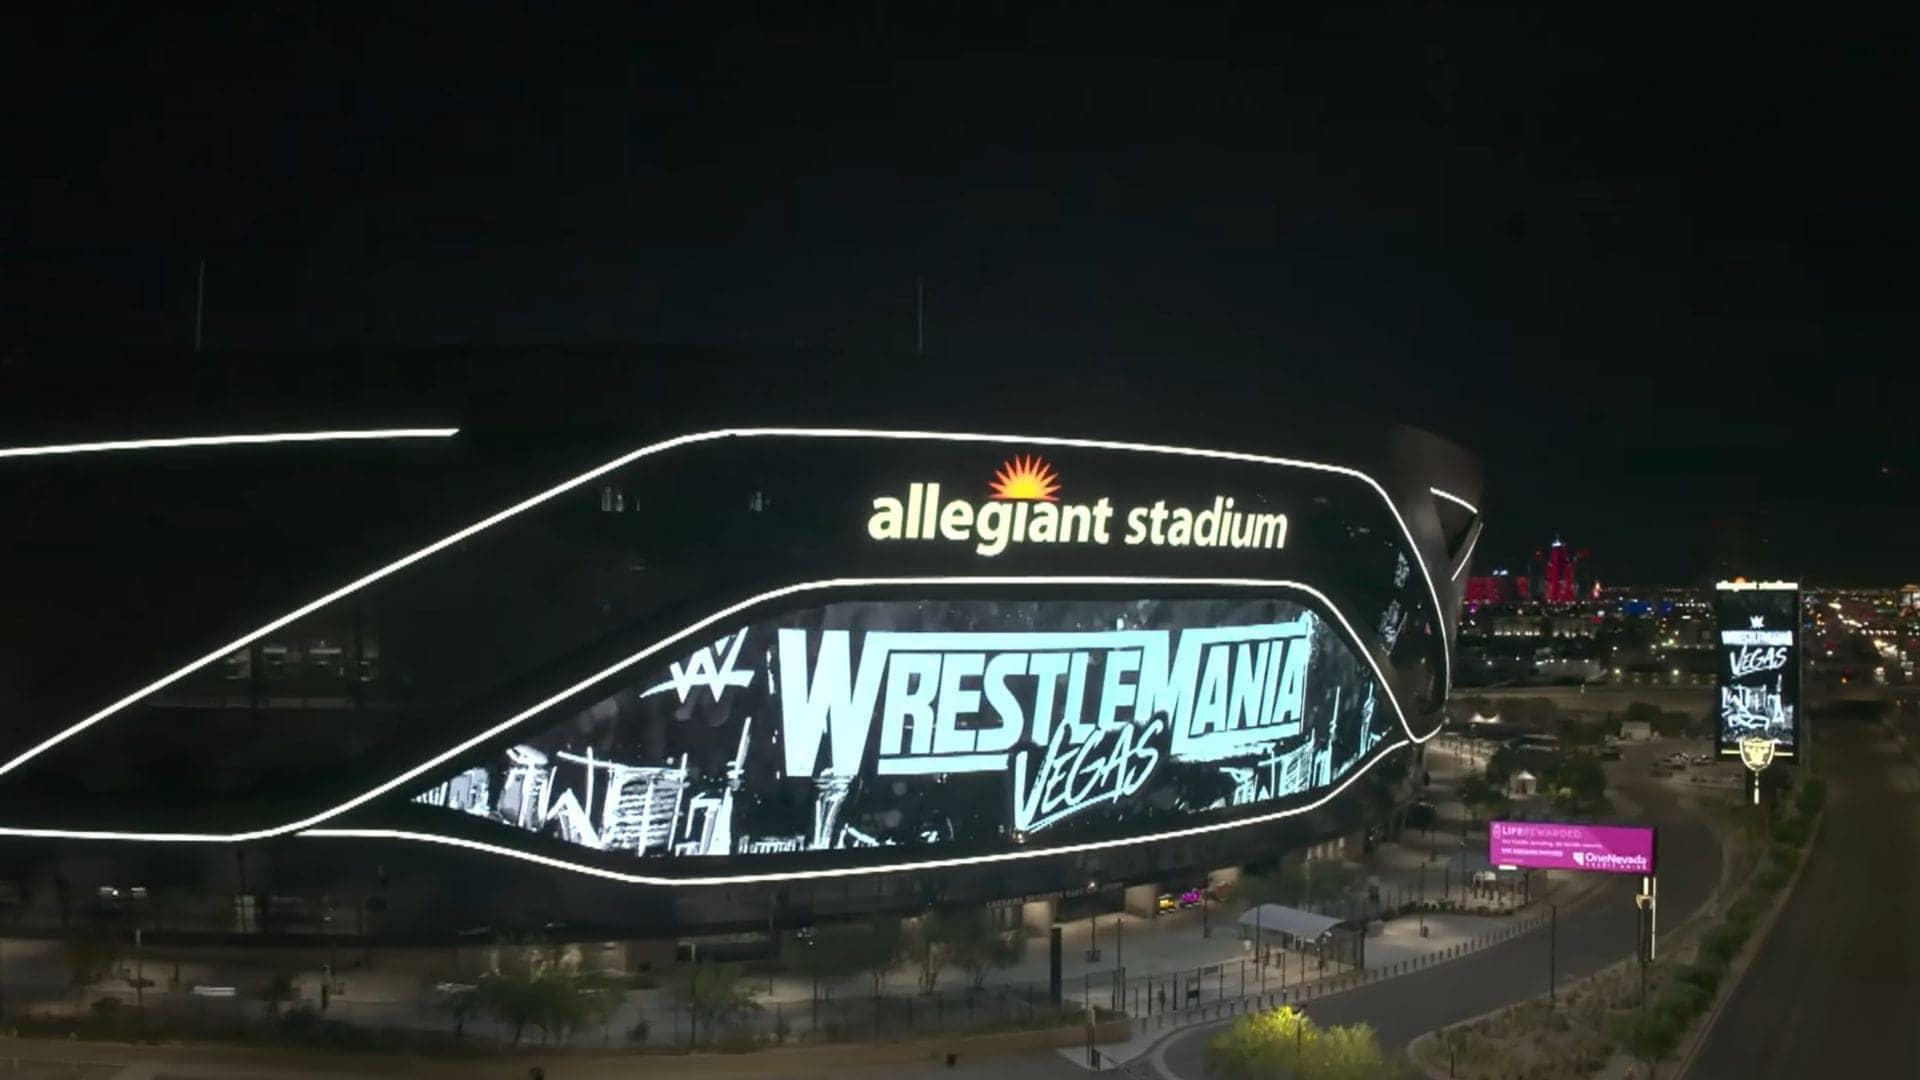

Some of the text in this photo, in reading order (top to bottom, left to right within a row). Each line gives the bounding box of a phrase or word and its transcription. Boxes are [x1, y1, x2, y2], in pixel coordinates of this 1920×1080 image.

[867, 482, 1289, 557] allegiant stadium
[1730, 642, 1787, 676] VEGAS
[1014, 718, 1164, 833] VEGAS
